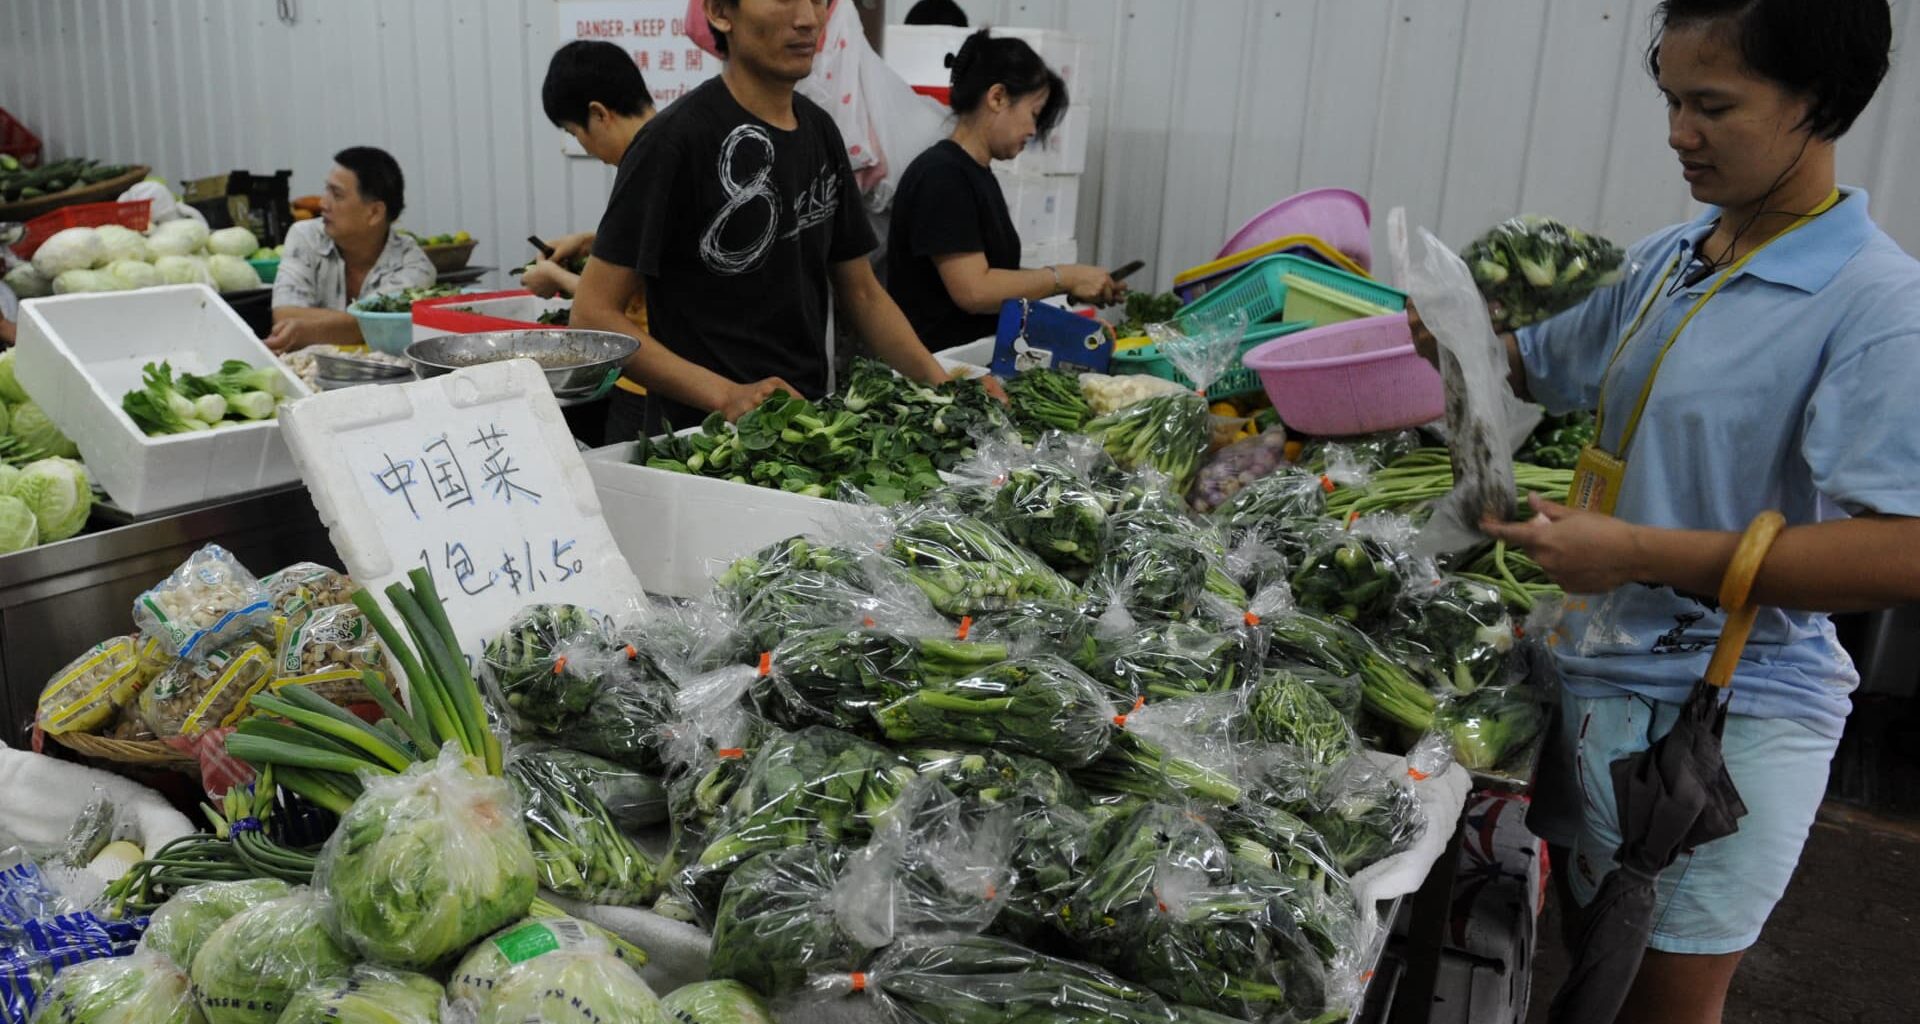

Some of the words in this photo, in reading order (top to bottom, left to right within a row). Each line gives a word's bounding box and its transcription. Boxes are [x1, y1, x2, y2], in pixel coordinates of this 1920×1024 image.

[700, 123, 780, 277] 8
[371, 422, 543, 521] 中国菜
